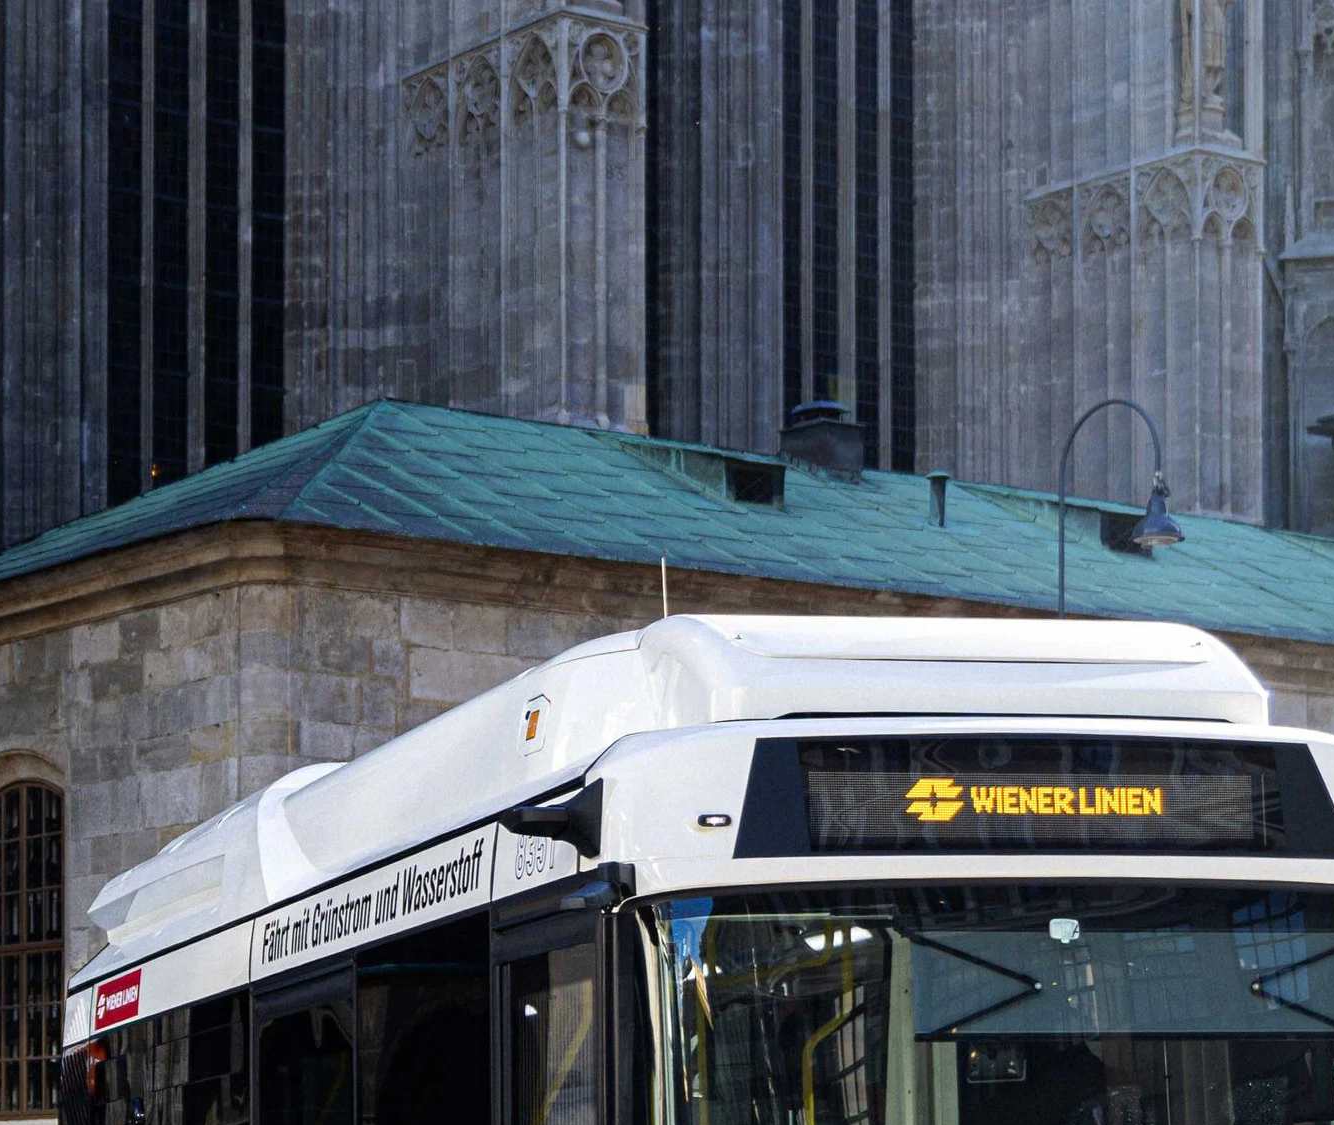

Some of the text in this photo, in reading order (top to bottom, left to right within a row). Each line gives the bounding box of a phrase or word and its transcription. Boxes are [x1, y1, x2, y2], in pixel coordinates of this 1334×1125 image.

[970, 786, 1162, 815] WIENER LINIEN
[261, 837, 485, 964] Fährt mit Grünstrom und Wasserstoff
